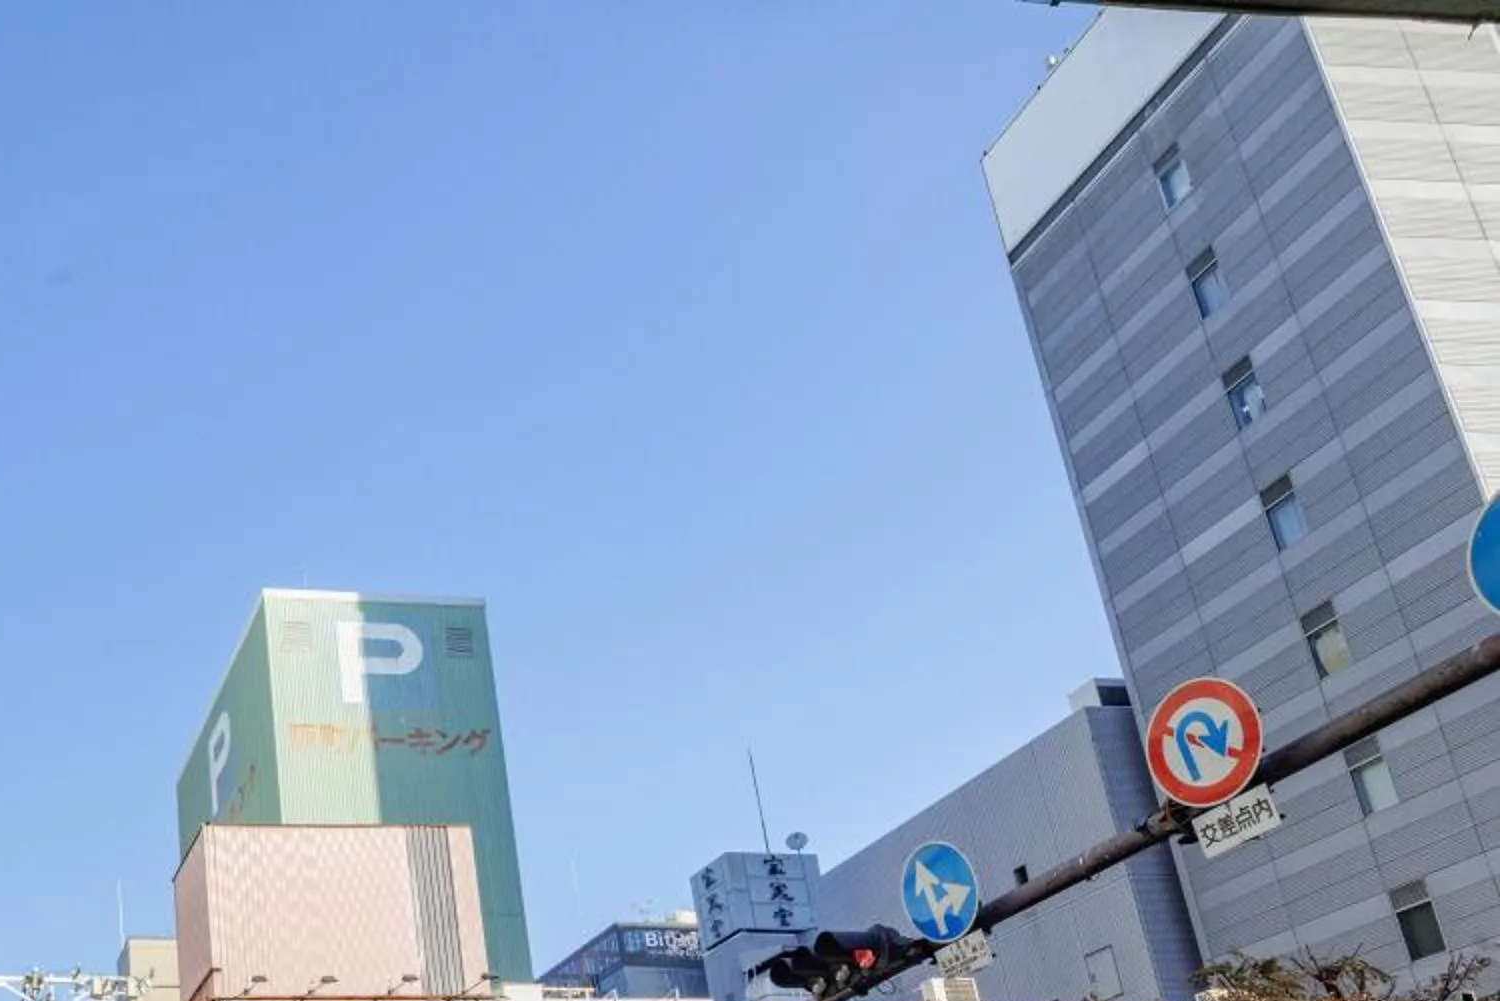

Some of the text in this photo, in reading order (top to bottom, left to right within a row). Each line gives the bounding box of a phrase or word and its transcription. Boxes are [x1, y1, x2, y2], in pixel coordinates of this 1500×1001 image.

[337, 620, 424, 704] P
[208, 711, 231, 816] P
[1200, 798, 1274, 848] 交差点内
